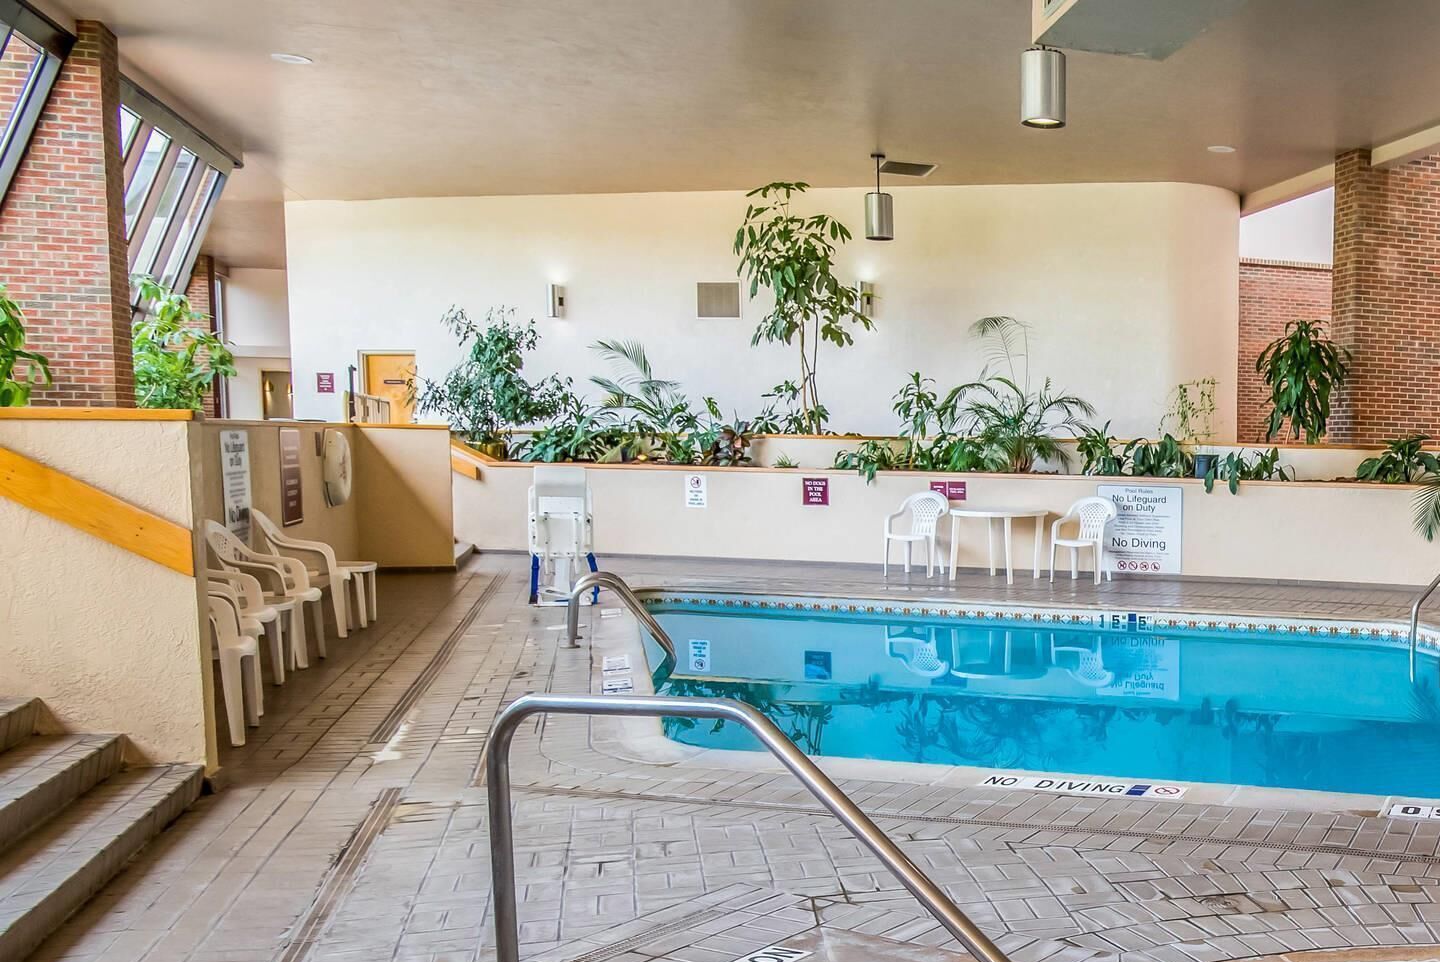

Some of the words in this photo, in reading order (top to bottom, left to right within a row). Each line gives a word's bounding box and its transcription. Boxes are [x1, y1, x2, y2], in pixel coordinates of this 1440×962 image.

[1112, 494, 1124, 503] No
[1126, 494, 1167, 504] Lifeguard
[1135, 504, 1156, 513] Duty
[1112, 537, 1128, 548] No
[1131, 538, 1166, 551] Diving
[984, 776, 1018, 786] NO
[1034, 779, 1126, 794] DIVING
